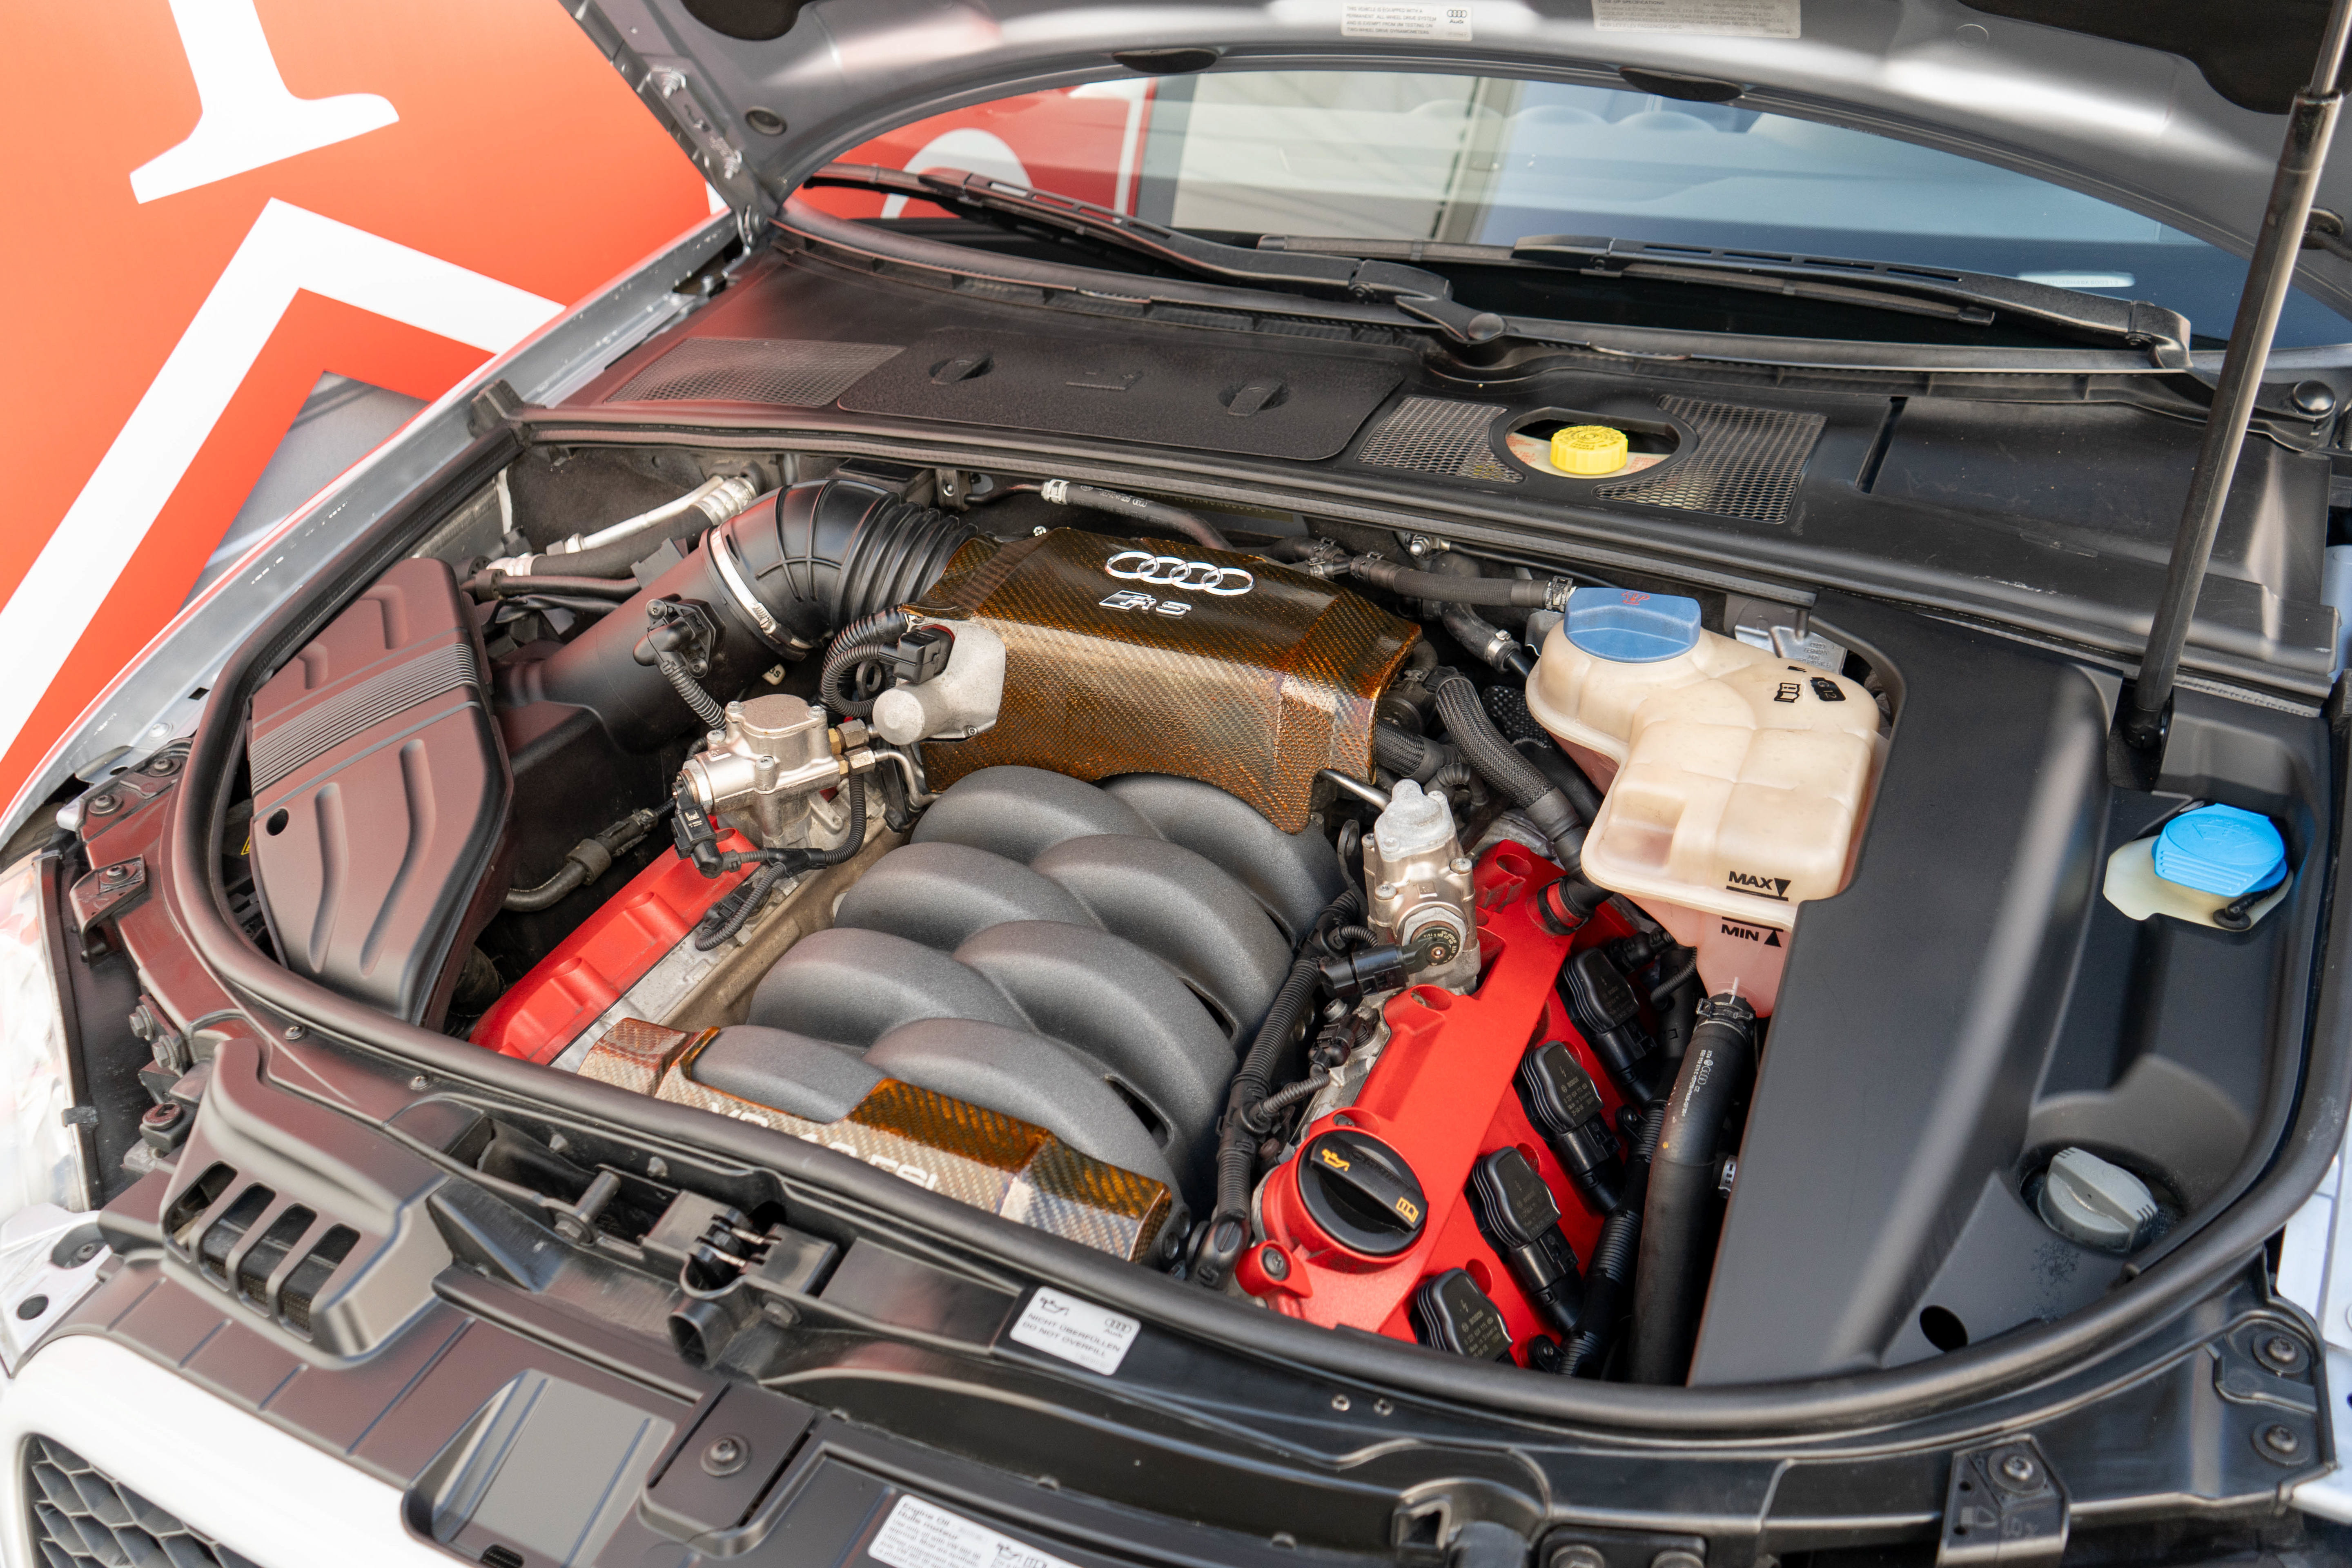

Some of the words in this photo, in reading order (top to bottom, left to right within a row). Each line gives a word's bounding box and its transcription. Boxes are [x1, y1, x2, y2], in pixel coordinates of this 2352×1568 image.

[1098, 590, 1192, 617] RS
[1823, 690, 1837, 699] 12
[1728, 871, 1773, 891] MAX
[1722, 924, 1760, 942] MIN
[1566, 1076, 1579, 1088] BOSCH
[1469, 1309, 1483, 1325] BOSCH
[1022, 1321, 1037, 1331] DO
[1039, 1327, 1060, 1339] NOT
[1062, 1336, 1107, 1357] OVERFILL
[1027, 1312, 1057, 1328] NICHT
[1059, 1323, 1121, 1352] ÜBERFÜLLEN
[1104, 1327, 1123, 1338] Audi
[902, 1502, 934, 1520] Engine
[936, 1517, 950, 1526] Oil
[898, 1510, 921, 1523] Huile
[924, 1521, 958, 1539] moteur
